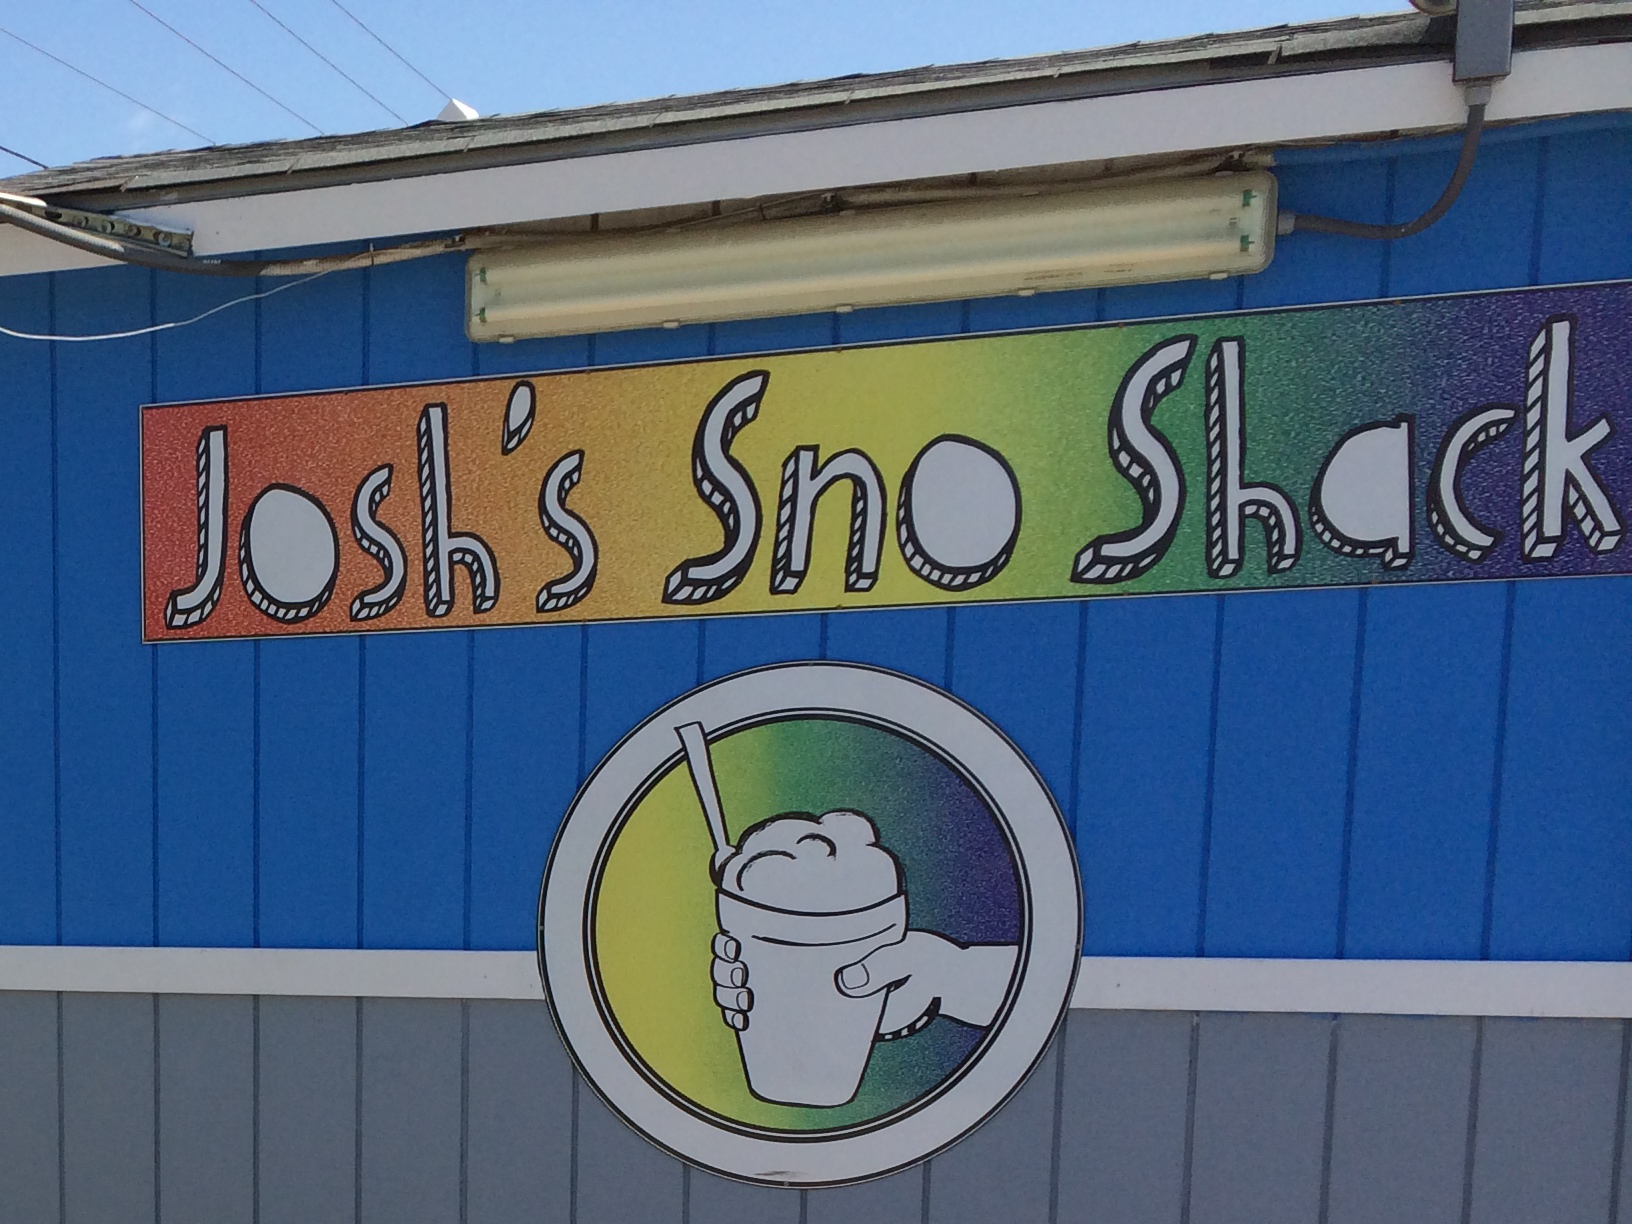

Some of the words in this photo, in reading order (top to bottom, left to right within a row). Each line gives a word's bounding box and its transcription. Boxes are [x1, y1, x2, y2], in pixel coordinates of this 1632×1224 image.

[165, 380, 599, 629] Josh's
[661, 369, 1023, 605] Sno
[1070, 313, 1627, 585] Shack
